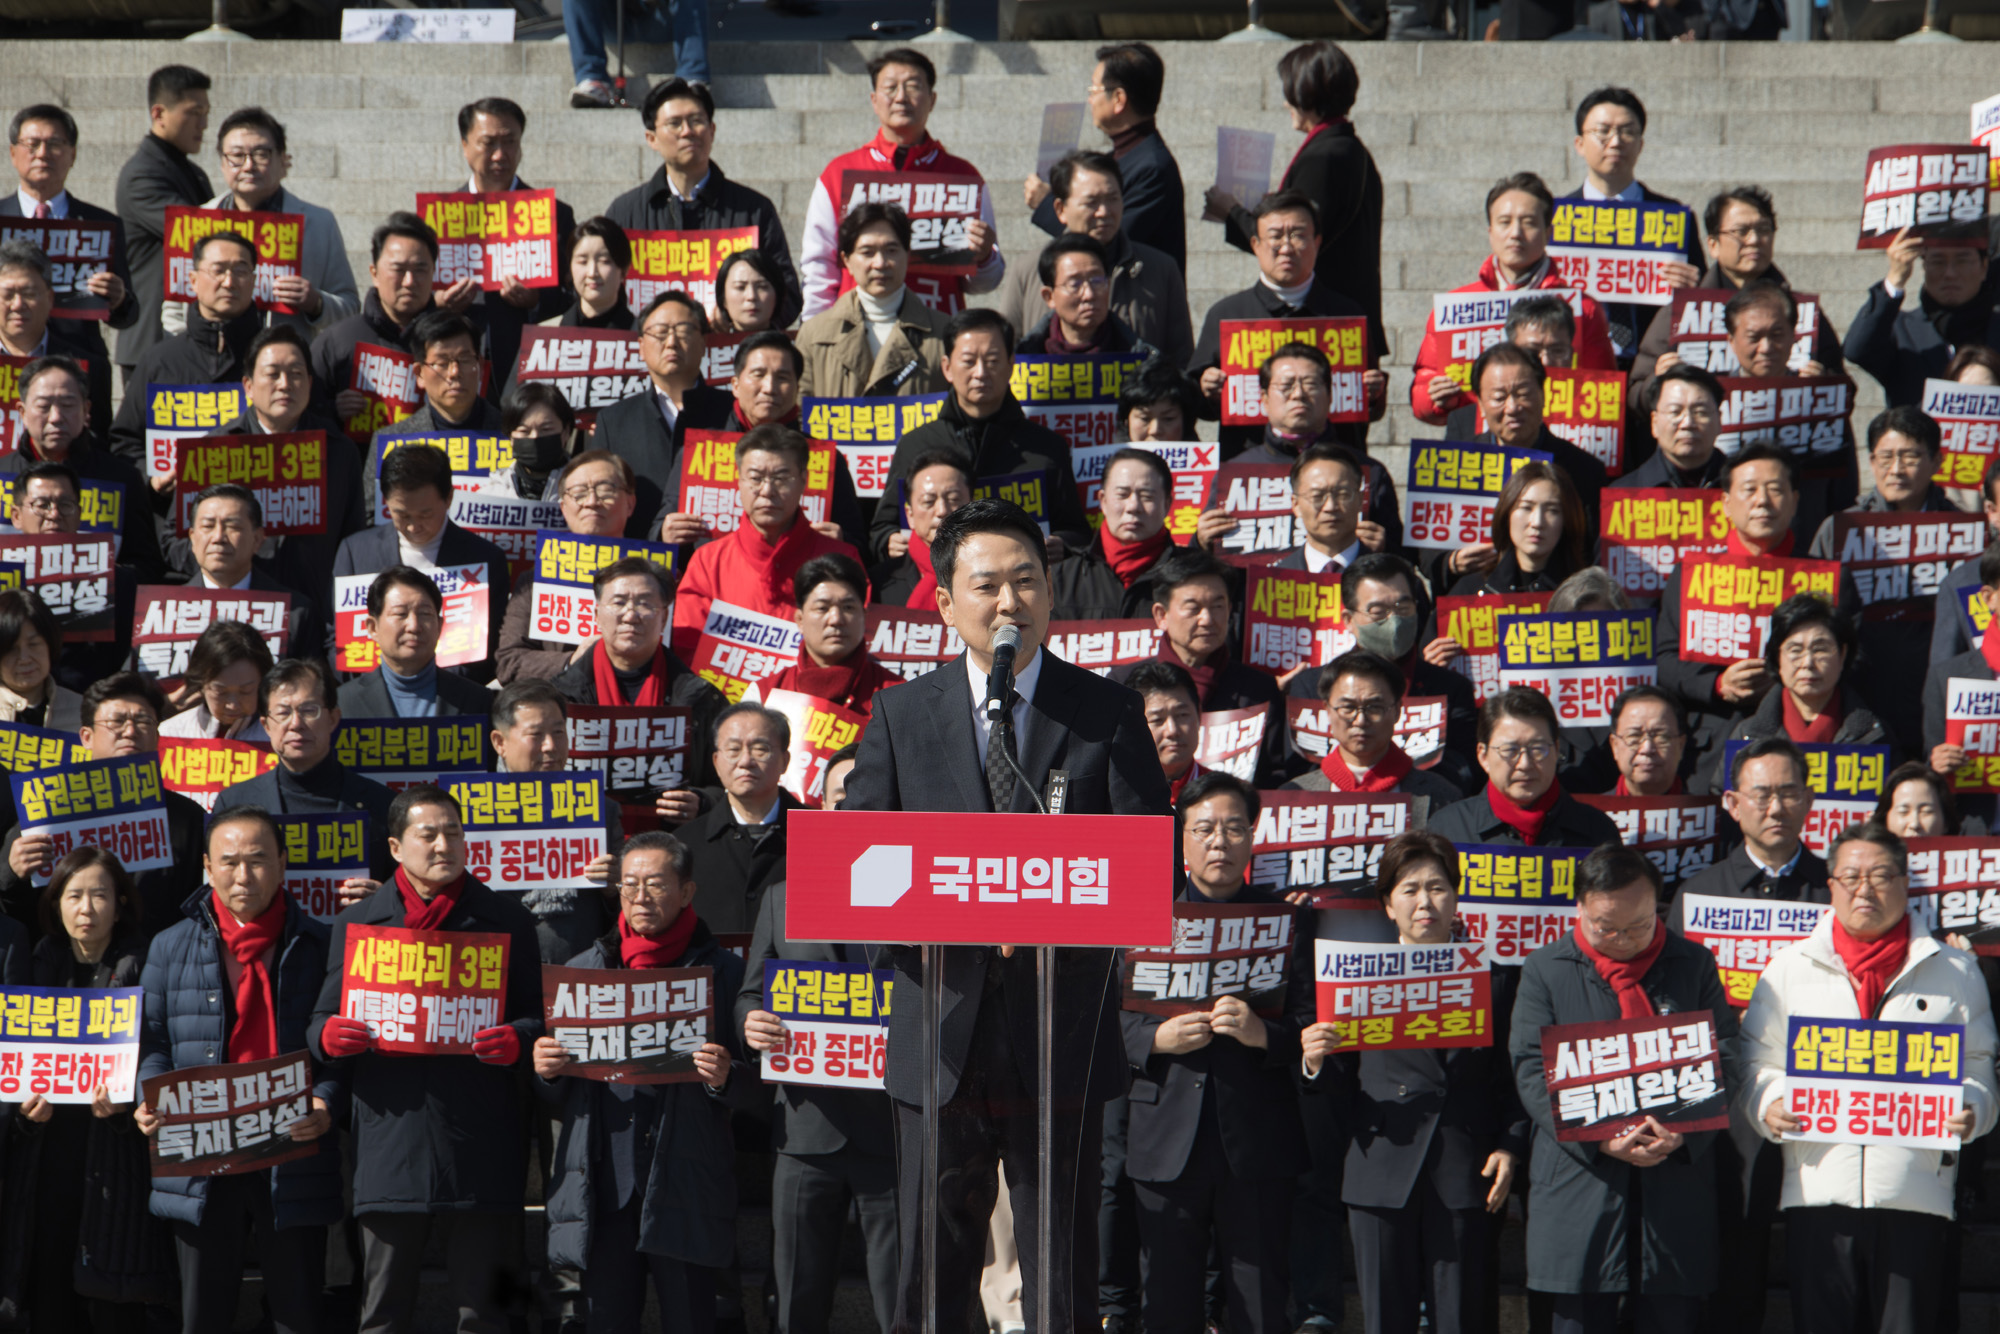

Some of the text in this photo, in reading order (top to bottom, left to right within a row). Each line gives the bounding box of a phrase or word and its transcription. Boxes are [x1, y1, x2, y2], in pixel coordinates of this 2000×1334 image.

[1865, 152, 1988, 197] 사법 파괴
[425, 195, 552, 240] 사법파괴 3법
[913, 183, 978, 214] 파괴
[1861, 186, 1986, 237] 독재 완성
[48, 229, 110, 260] 파괴
[259, 222, 299, 261] 3법
[1552, 204, 1686, 249] 삼권분립 파괴
[630, 237, 712, 278] 사법파괴
[527, 338, 592, 372] 사법
[1323, 327, 1363, 367] 3법
[1008, 361, 1094, 402] 삼권분립
[1580, 380, 1621, 420] 3법
[806, 403, 896, 442] 삼권분립
[1720, 383, 1847, 425] 사법 파괴
[183, 440, 321, 485] 사법파괴 3법
[1415, 447, 1503, 492] 삼권분립
[79, 487, 120, 527] 파괴
[455, 502, 528, 526] 사법파괴
[1223, 476, 1294, 514] 사법
[1411, 501, 1453, 544] 당장
[1607, 498, 1704, 541] 사법파괴
[40, 542, 109, 578] 파괴
[1841, 520, 1987, 563] 사법 파괴
[40, 578, 109, 615] 완성
[1251, 577, 1341, 625] 사법파괴
[1687, 561, 1784, 608] 사법파괴
[140, 599, 212, 636] 사법
[538, 592, 573, 637] 당장
[709, 613, 787, 651] 사법파괴
[1685, 609, 1751, 660] 대통령은
[868, 618, 942, 656] 사법
[1503, 617, 1653, 664] 삼권분립 파괴
[335, 722, 482, 768] 삼권분립 파괴
[614, 715, 690, 751] 파괴
[1208, 709, 1267, 756] 파괴
[160, 745, 257, 788] 사법파괴
[611, 752, 684, 790] 완성
[1834, 752, 1885, 797] 파괴
[21, 767, 114, 822] 삼권분립
[119, 760, 162, 806] 파괴
[449, 778, 600, 825] 삼권분립 파괴
[316, 819, 365, 864] 파괴
[1253, 802, 1407, 845] 사법 파괴
[1644, 804, 1717, 843] 파괴
[929, 855, 1111, 905] 국민의힘
[1252, 849, 1325, 887] 독재
[1217, 915, 1292, 952] 파괴
[1690, 906, 1771, 932] 사법파괴
[349, 937, 503, 990] 사법파괴 3법
[1132, 953, 1287, 1001] 독재 완성
[1321, 948, 1454, 979] 사법파괴 악법
[553, 977, 708, 1020] 사법 파괴
[769, 968, 874, 1018] 삼권분립
[1334, 977, 1474, 1017] 대한민국
[0, 993, 138, 1039] 권분립 파괴
[1332, 1008, 1486, 1048] 헌정 수호!
[553, 1014, 708, 1064] 독재 완성
[1553, 1020, 1712, 1081] 사법 파괴
[1792, 1024, 1960, 1080] 삼권분립 파괴
[157, 1059, 309, 1117] 사법 파괴
[1558, 1060, 1718, 1127] 독재 완성
[156, 1095, 310, 1161] 독재 완성
[1791, 1087, 1955, 1140] 당장 중단하라!
